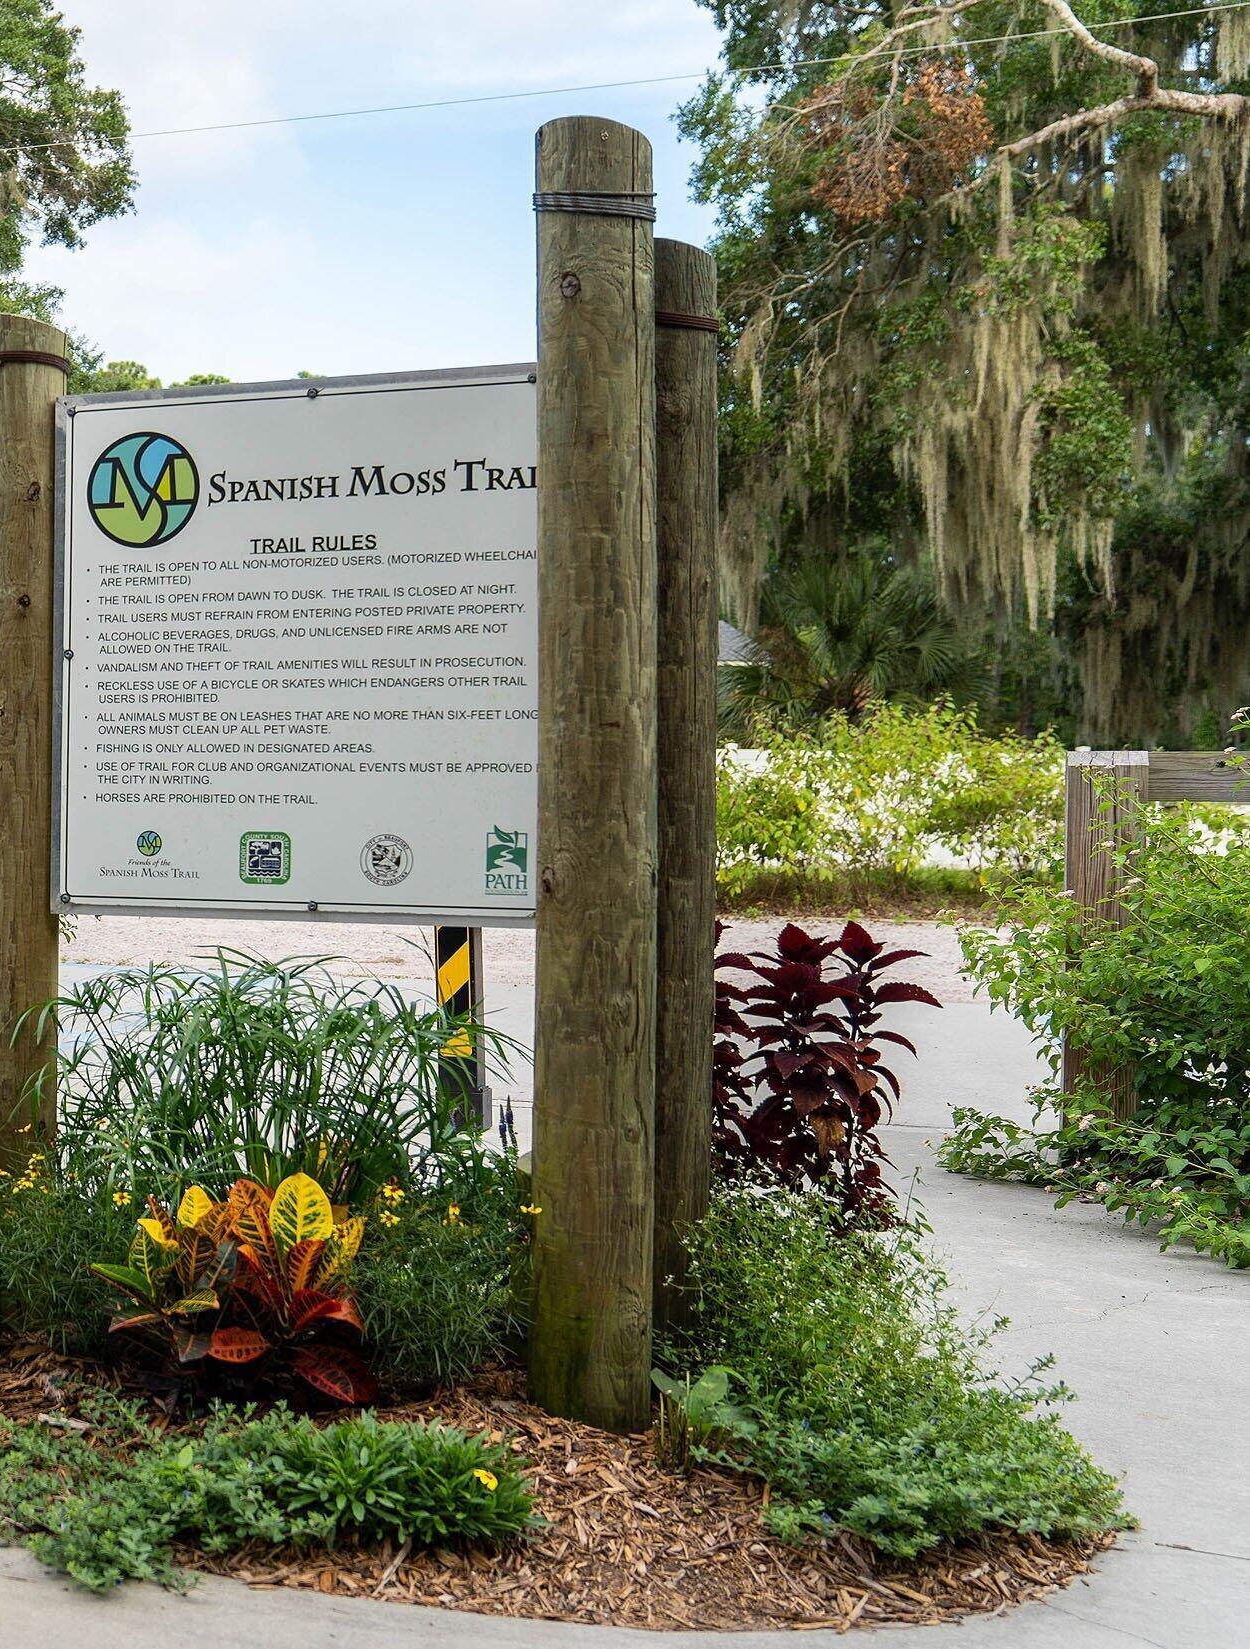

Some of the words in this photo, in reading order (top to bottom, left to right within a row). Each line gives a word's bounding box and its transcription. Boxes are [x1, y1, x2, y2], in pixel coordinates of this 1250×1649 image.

[453, 458, 538, 492] TRAI
[249, 537, 307, 554] TRAIL
[311, 535, 378, 552] RULES
[98, 565, 120, 574] THE
[121, 564, 153, 573] TRAIL
[155, 563, 166, 572] IS
[168, 562, 200, 572] OPEN
[201, 561, 218, 570] TO
[218, 561, 240, 570] ALL
[242, 557, 339, 569] NON-MOTORIZED
[341, 555, 385, 566] USERS.
[387, 553, 463, 566] (MOTORIZED
[463, 550, 537, 561] WHEELCHAI
[99, 577, 123, 587] ARE
[125, 575, 192, 586] PERMITTED)
[97, 596, 120, 605] THE
[121, 595, 153, 604] TRAIL
[154, 594, 166, 603] IS
[167, 593, 200, 603] OPEN
[201, 592, 235, 602] FROM
[237, 592, 271, 601] DAWN
[272, 591, 289, 600] TO
[291, 590, 327, 600] DUSK.
[331, 589, 355, 598] THE
[356, 588, 391, 597] TRAIL
[393, 587, 405, 597] IS
[407, 586, 458, 596] CLOSED
[459, 585, 475, 595] AT
[477, 584, 517, 594] NIGHT.
[97, 614, 129, 623] TRAIL
[130, 612, 168, 622] USERS
[170, 612, 203, 621] MUST
[204, 610, 254, 620] REFRAIN
[256, 609, 290, 619] FROM
[292, 608, 352, 618] ENTERING
[354, 607, 404, 617] POSTED
[406, 605, 455, 615] PRIVATE
[457, 603, 526, 614] PROPERTY.
[97, 631, 160, 641] ALCOHOLIC
[162, 630, 233, 642] BEVERAGES,
[235, 628, 279, 639] DRUGS,
[281, 628, 307, 637] AND
[308, 626, 384, 637] UNLICENSED
[386, 625, 414, 635] FIRE
[415, 625, 452, 634] ARMS
[453, 624, 480, 634] ARE
[482, 624, 509, 633] NOT
[98, 645, 152, 655] ALLOWED
[154, 644, 171, 653] ON
[172, 644, 195, 652] THE
[197, 643, 231, 652] TRAIL.
[96, 663, 158, 672] VANDALISM
[159, 662, 184, 671] AND
[185, 661, 222, 671] THEFT
[223, 661, 241, 670] OF
[241, 661, 275, 670] TRAIL
[276, 660, 339, 670] AMENITIES
[340, 659, 369, 669] WILL
[371, 658, 418, 668] RESULT
[419, 658, 432, 667] IN
[434, 657, 527, 667] PROSECUTION.
[97, 681, 155, 690] RECKLESS
[157, 681, 180, 690] USE
[182, 680, 198, 690] OF
[200, 681, 209, 689] A
[210, 680, 259, 689] BICYCLE
[261, 679, 279, 689] OR
[281, 679, 326, 688] SKATES
[327, 678, 368, 688] WHICH
[370, 677, 445, 687] ENDANGERS
[447, 675, 490, 687] OTHER
[491, 676, 528, 686] TRAIL
[98, 694, 136, 703] USERS
[138, 694, 149, 703] IS
[151, 693, 220, 703] PROHIBITED.
[96, 713, 116, 722] ALL
[117, 712, 166, 723] ANIMALS
[168, 712, 201, 721] MUST
[202, 712, 218, 721] BE
[219, 712, 238, 721] ON
[240, 711, 293, 721] LEASHES
[294, 711, 324, 720] THAT
[325, 711, 350, 720] ARE
[352, 711, 371, 720] NO
[373, 711, 409, 720] MORE
[411, 711, 444, 720] THAN
[447, 710, 502, 720] SIX-FEET
[504, 710, 538, 719] LONG
[98, 725, 147, 734] OWNERS
[148, 725, 180, 734] MUST
[182, 725, 220, 734] CLEAN
[222, 725, 238, 734] UP
[239, 725, 261, 734] ALL
[263, 725, 286, 734] PET
[288, 725, 332, 734] WASTE.
[96, 744, 140, 753] FISHING
[142, 744, 153, 753] IS
[155, 744, 185, 753] ONLY
[185, 744, 241, 753] ALLOWED
[243, 744, 255, 752] IN
[257, 744, 331, 753] DESIGNATED
[332, 744, 375, 753] AREAS.
[96, 762, 118, 771] USE
[119, 762, 136, 771] OF
[137, 762, 169, 771] TRAIL
[171, 762, 196, 771] FOR
[197, 762, 228, 771] CLUB
[229, 762, 254, 771] AND
[256, 762, 357, 772] ORGANIZATIONAL
[359, 763, 407, 772] EVENTS
[409, 763, 444, 772] MUST
[446, 763, 463, 772] BE
[464, 763, 533, 773] APPROVED
[97, 775, 119, 784] THE
[121, 775, 147, 784] CITY
[149, 775, 160, 784] IN
[161, 775, 213, 784] WRITING.
[95, 793, 141, 802] HORSES
[142, 794, 166, 803] ARE
[168, 794, 238, 804] PROHIBITED
[238, 794, 256, 803] ON
[257, 795, 281, 804] THE
[282, 795, 318, 804] TRAIL.
[127, 858, 151, 866] Friends
[152, 858, 161, 867] of
[485, 873, 527, 890] PATH
